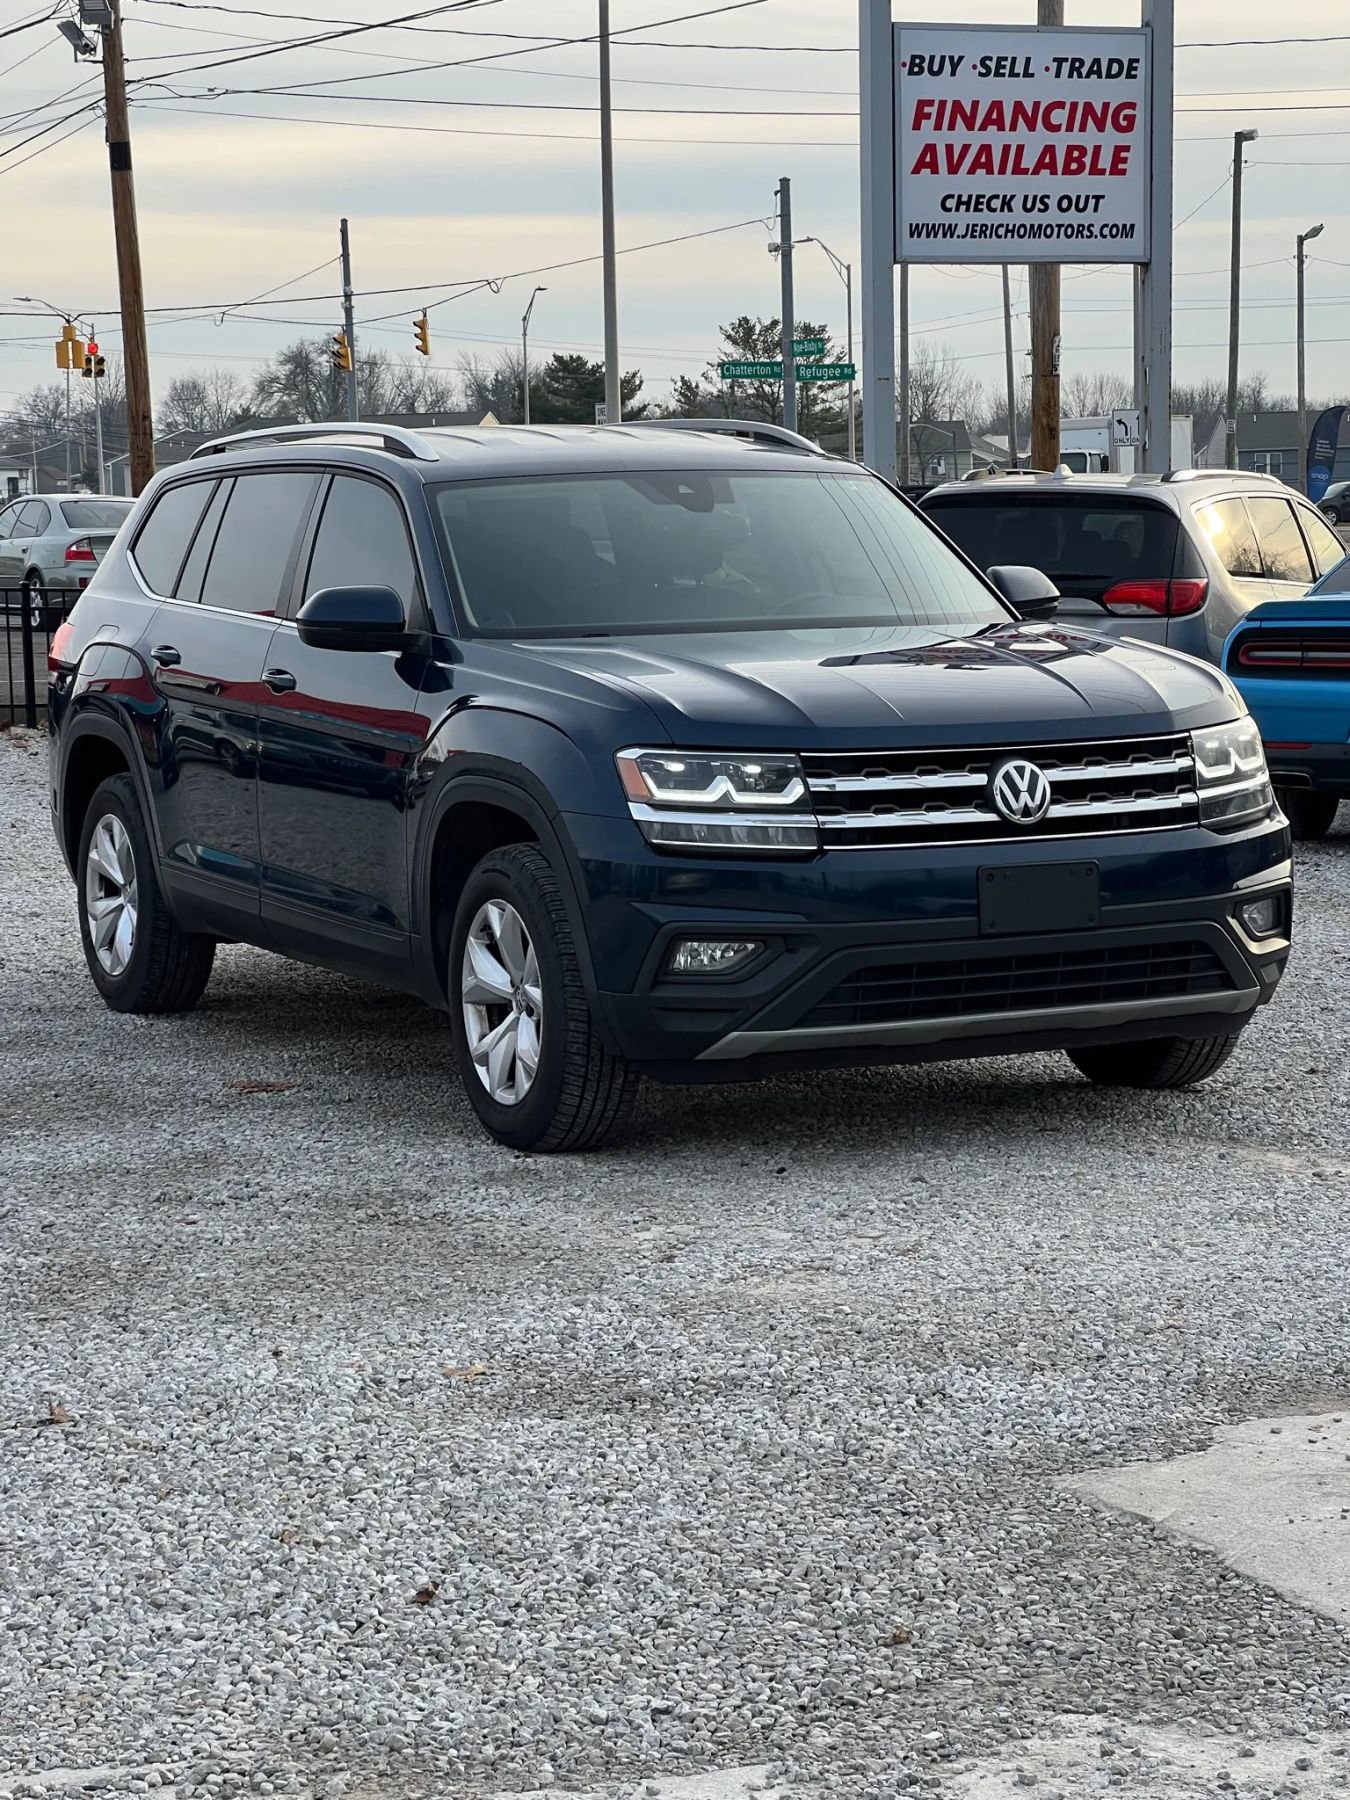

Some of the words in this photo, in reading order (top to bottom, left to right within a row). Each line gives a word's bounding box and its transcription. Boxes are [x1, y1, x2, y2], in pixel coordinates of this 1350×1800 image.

[911, 98, 1138, 133] FINANCING
[910, 143, 1132, 176] AVAILABLE
[940, 194, 1017, 213] CHECK
[1021, 194, 1050, 213] US
[1056, 194, 1105, 213] OUT
[908, 222, 1136, 240] WWW.JERICHOMOTORS.COM
[723, 364, 771, 376] Chatterton
[799, 366, 841, 379] Refugee
